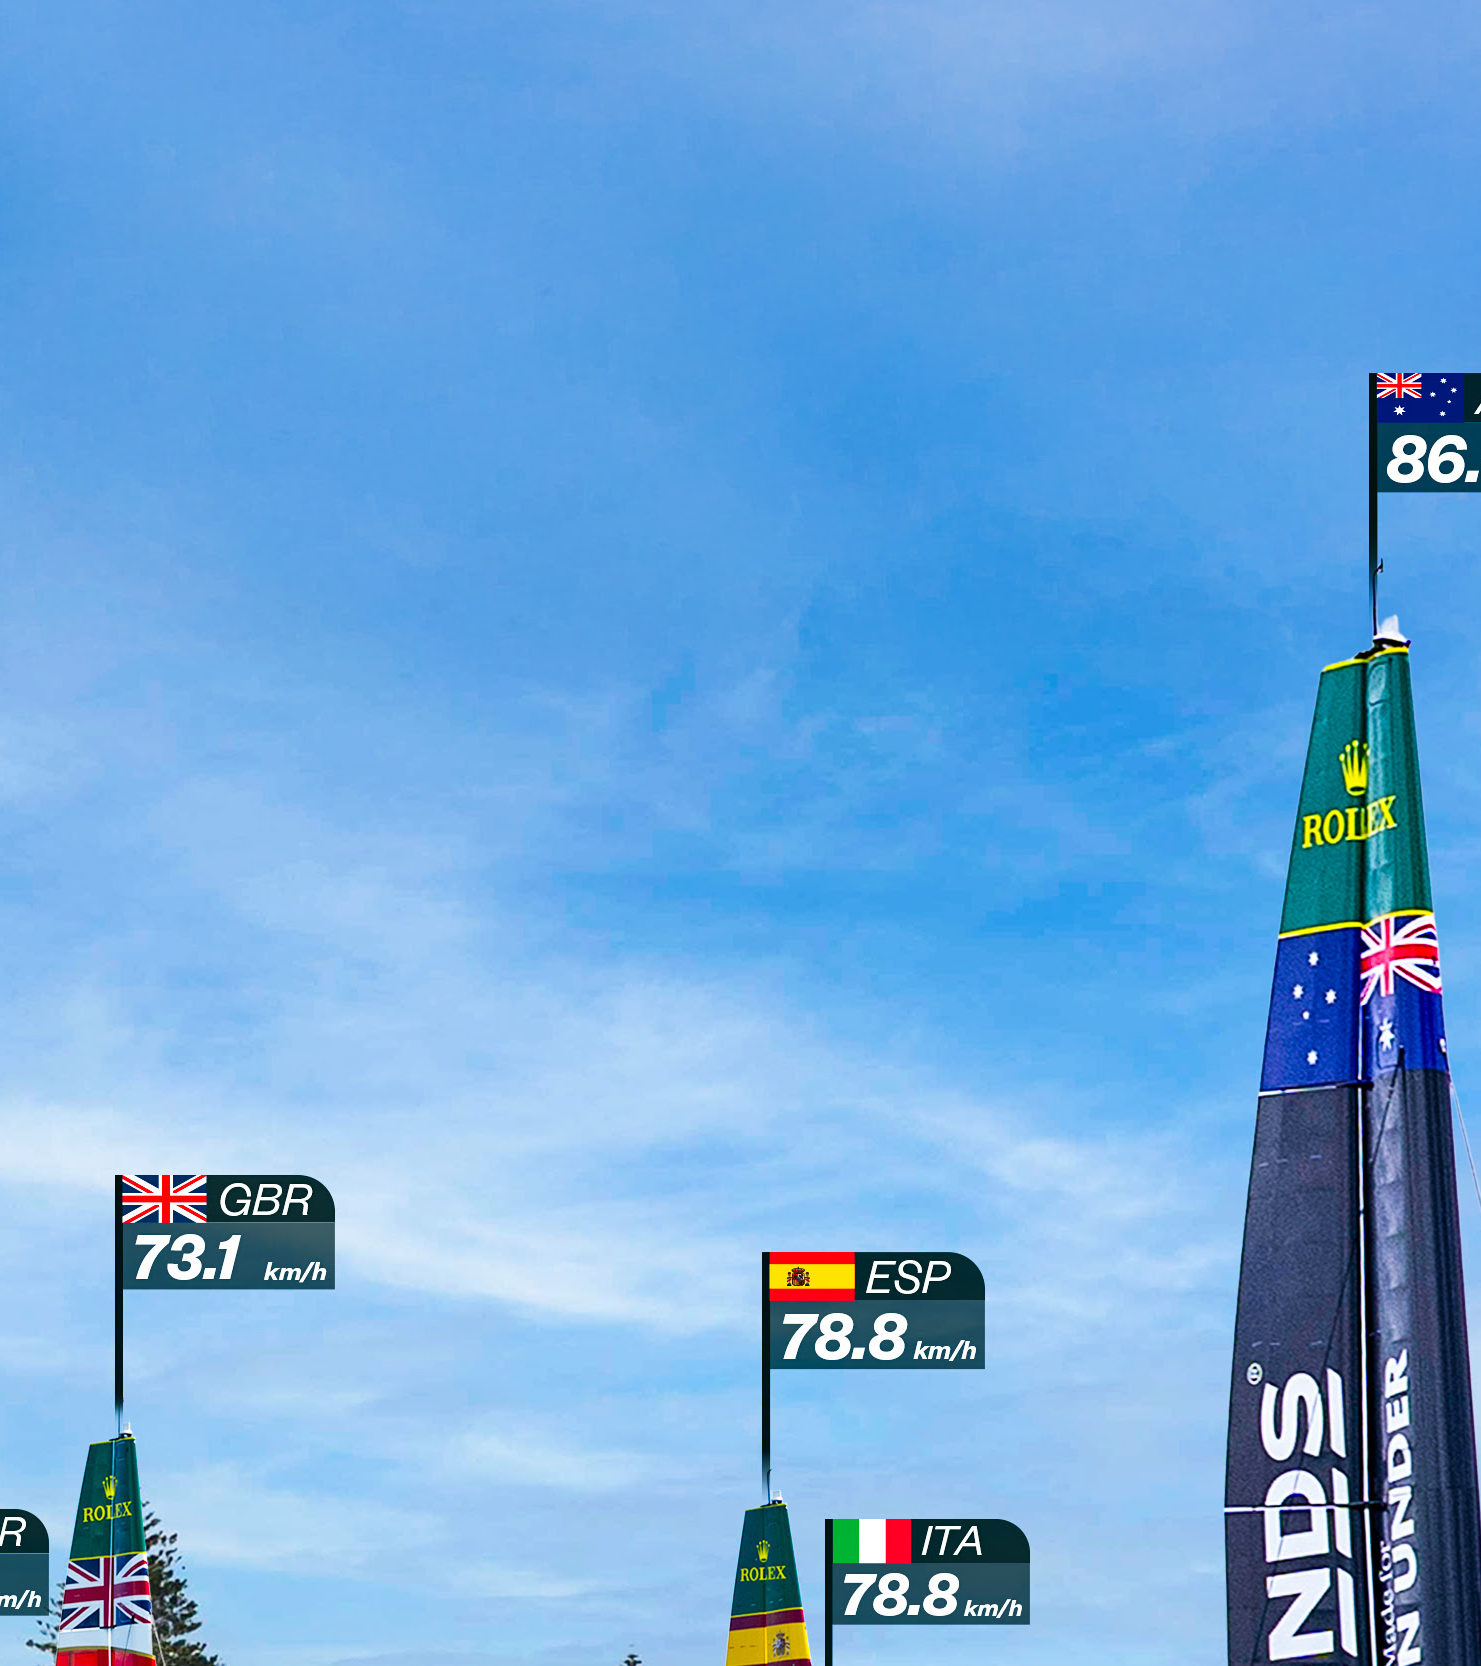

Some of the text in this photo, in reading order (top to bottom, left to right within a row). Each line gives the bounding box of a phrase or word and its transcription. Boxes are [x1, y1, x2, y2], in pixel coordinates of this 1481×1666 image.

[1301, 794, 1398, 849] ROLEX
[1384, 1347, 1419, 1595] UNDER
[82, 1500, 134, 1524] ROLEX
[740, 1565, 787, 1583] ROLEX
[1378, 1540, 1394, 1582] for
